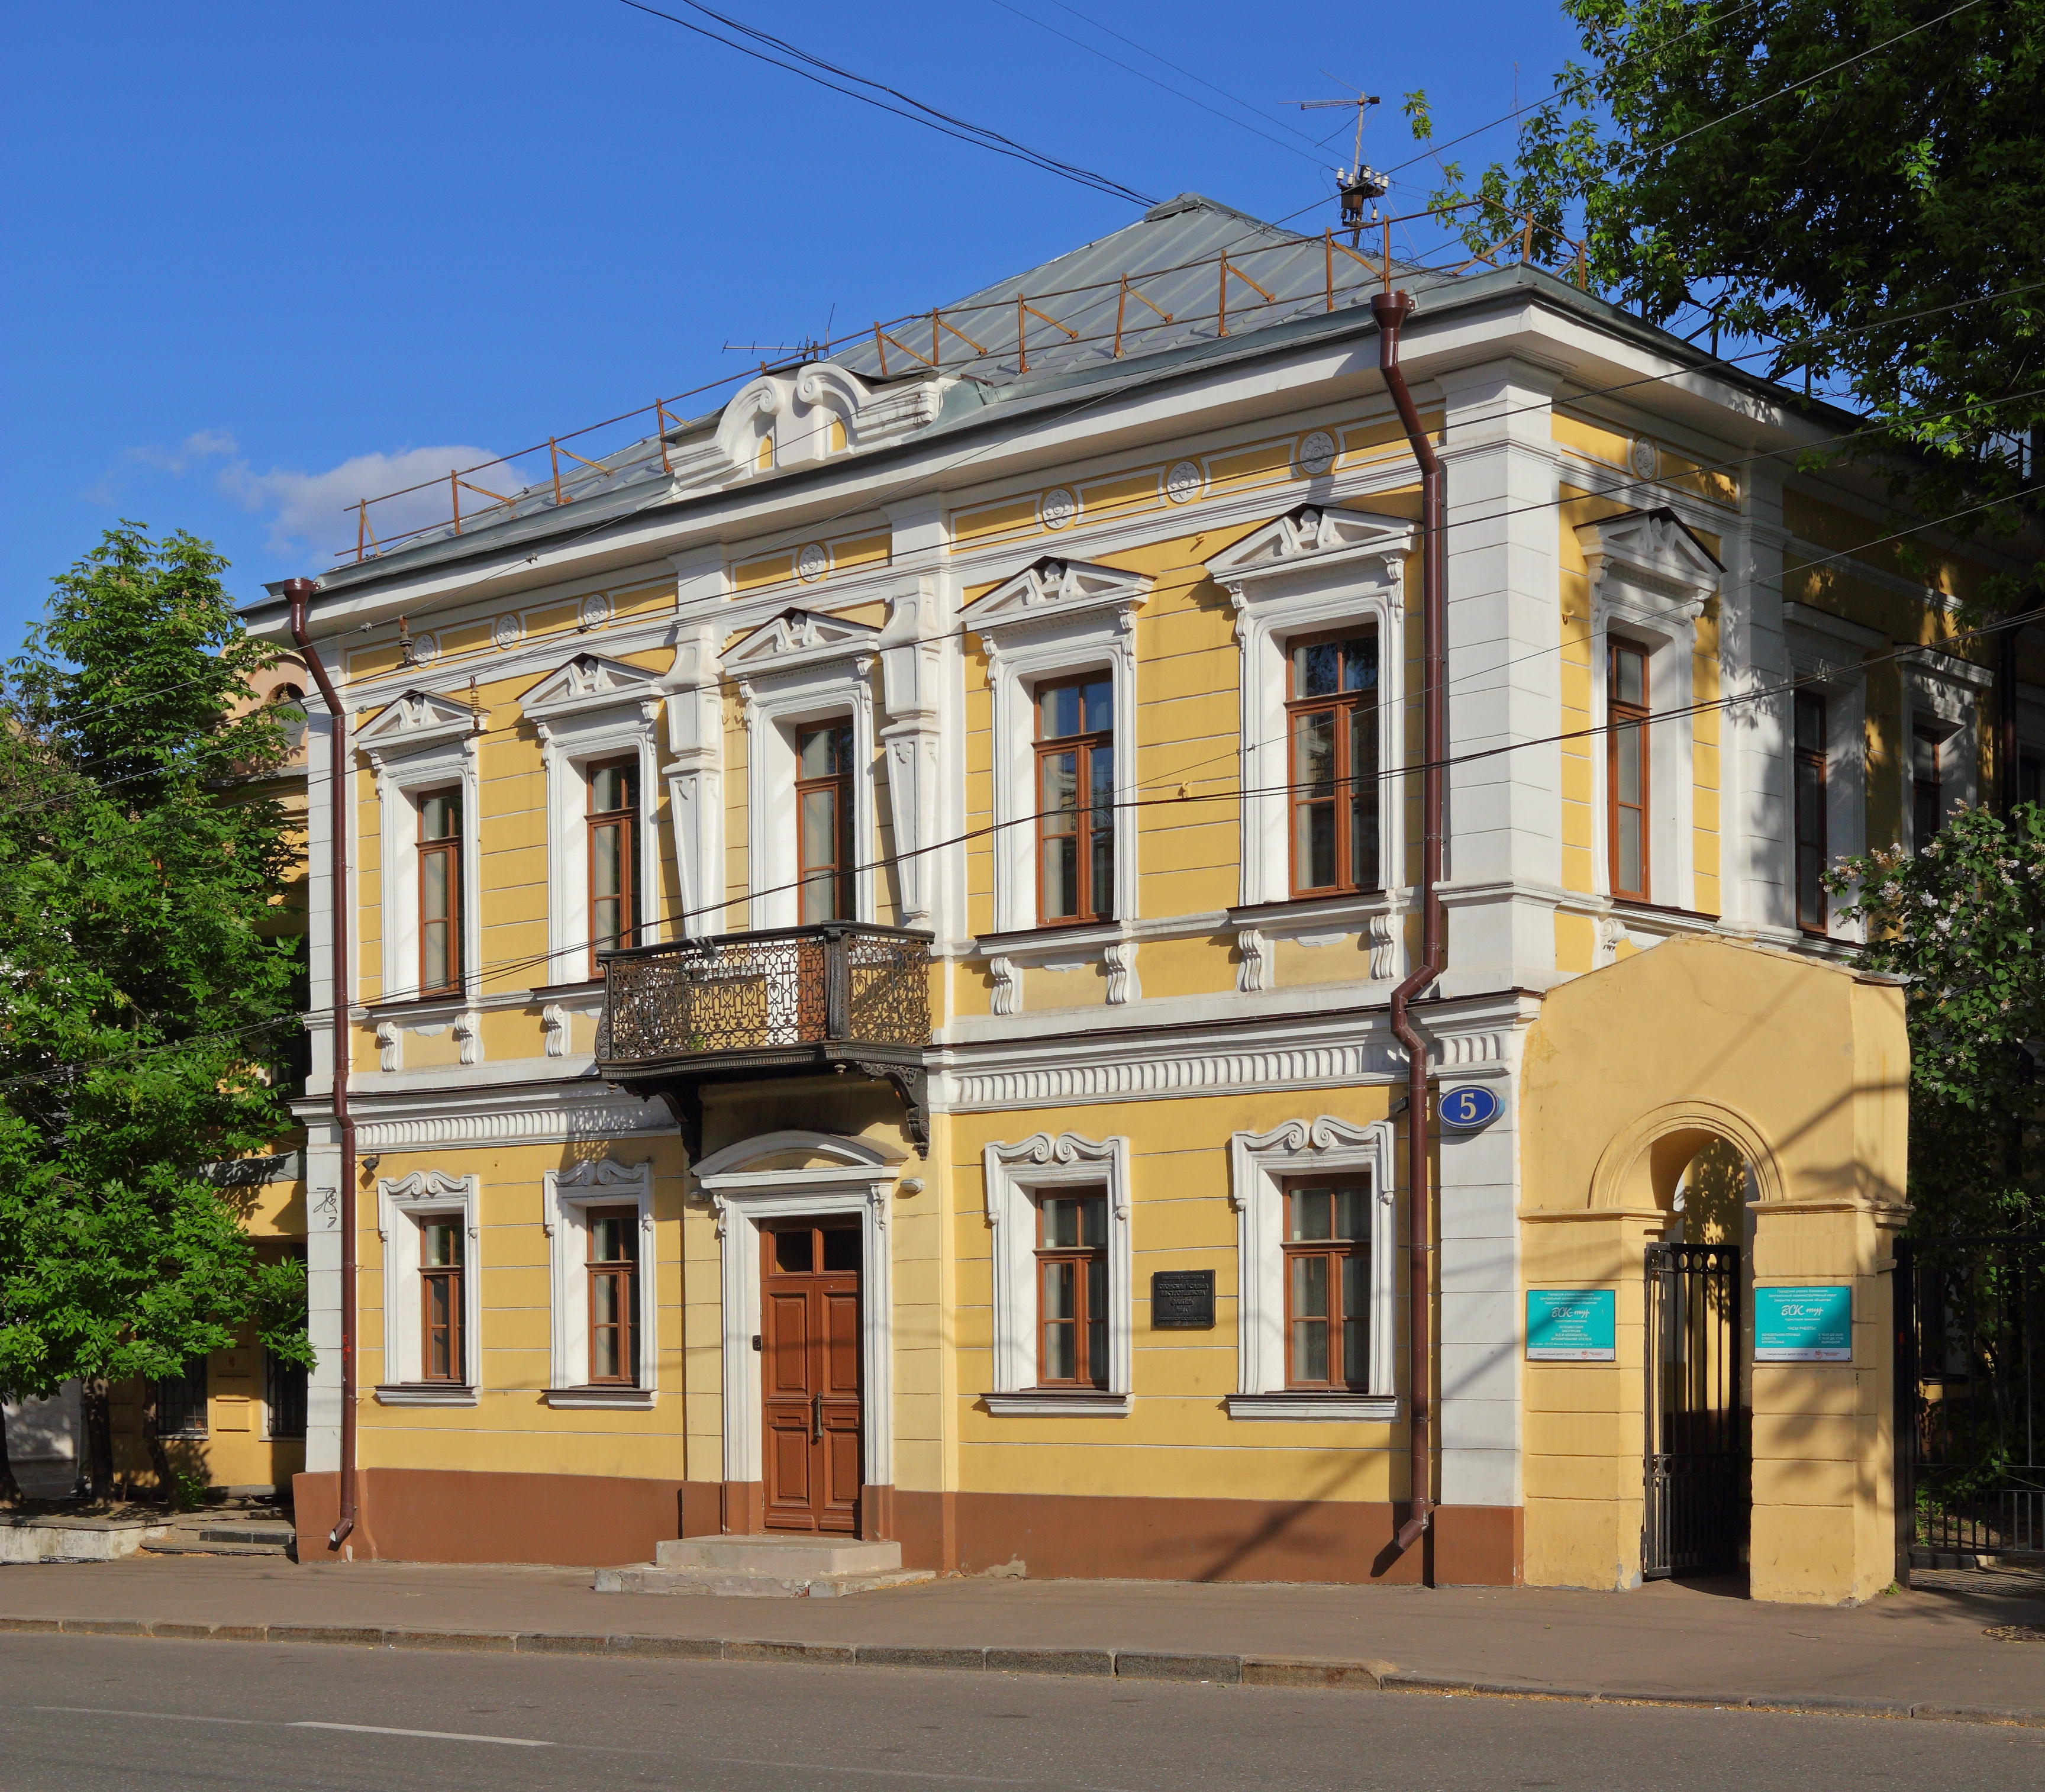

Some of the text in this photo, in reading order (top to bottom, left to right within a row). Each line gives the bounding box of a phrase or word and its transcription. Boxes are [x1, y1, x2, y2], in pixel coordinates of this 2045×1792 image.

[1460, 1092, 1476, 1120] 5
[1781, 1304, 1824, 1317] ВСК тур
